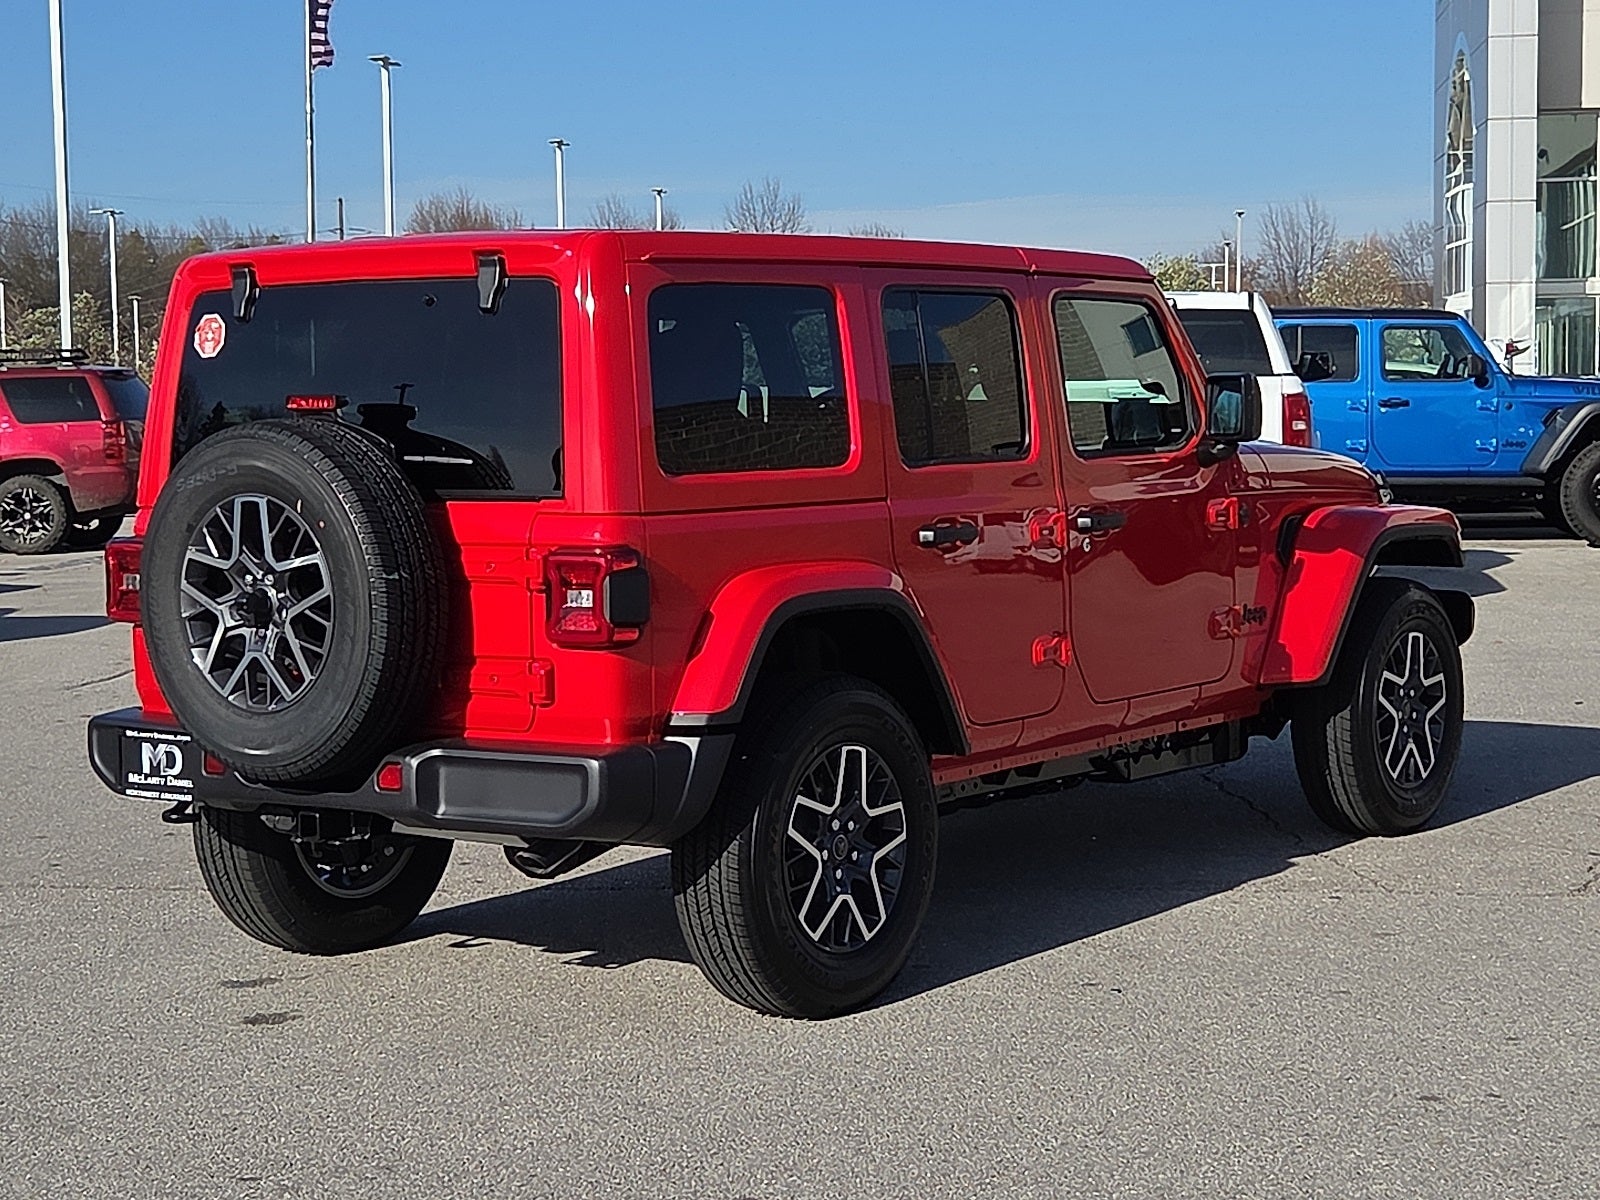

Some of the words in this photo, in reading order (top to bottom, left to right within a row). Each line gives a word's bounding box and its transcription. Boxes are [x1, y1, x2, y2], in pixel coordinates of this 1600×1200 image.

[1501, 439, 1527, 449] Jeep
[1241, 603, 1267, 626] Jeep
[141, 742, 183, 776] MD
